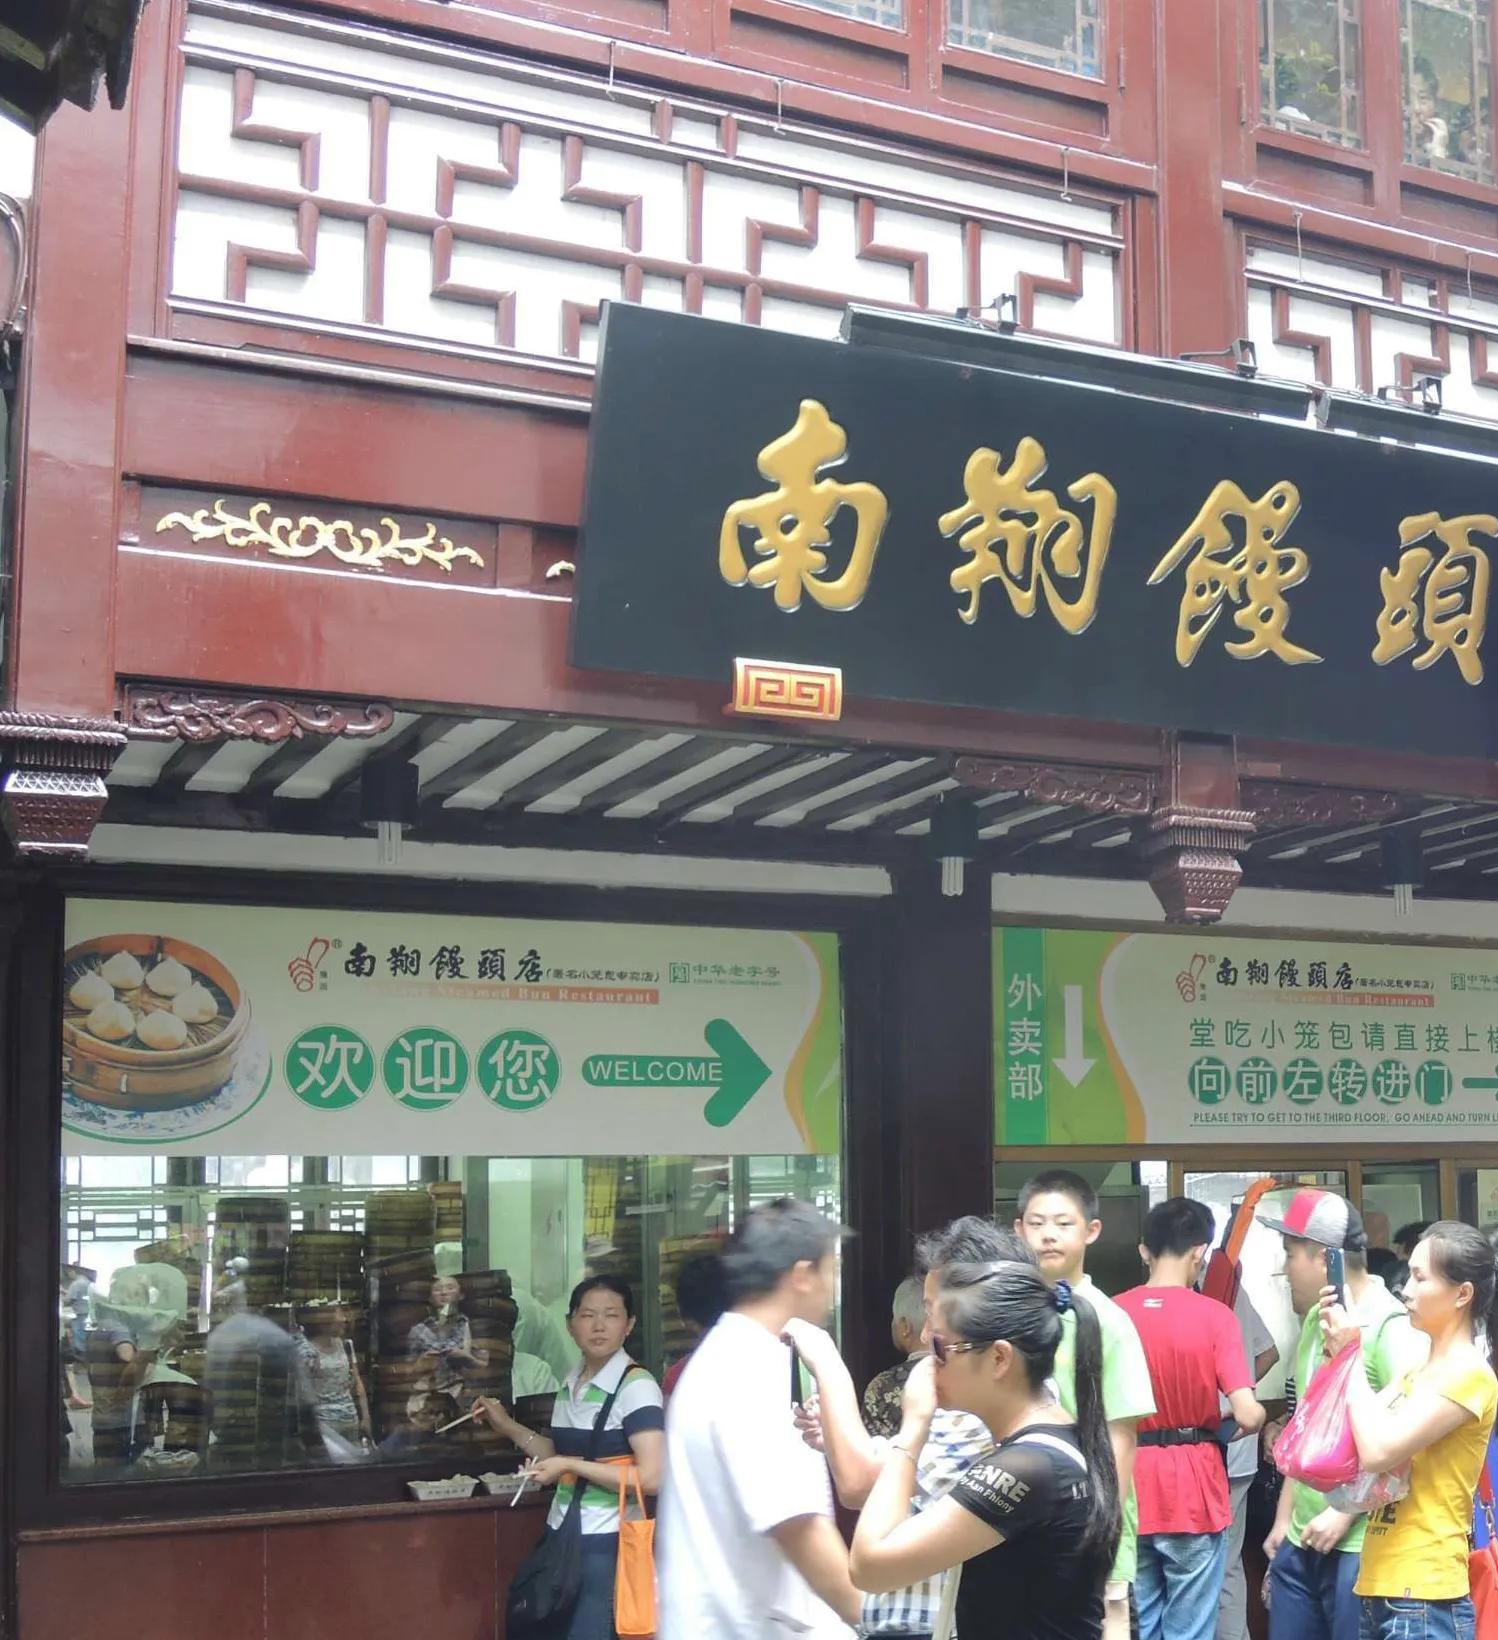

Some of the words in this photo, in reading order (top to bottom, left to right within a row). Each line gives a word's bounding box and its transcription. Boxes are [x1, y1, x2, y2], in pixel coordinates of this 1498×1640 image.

[559, 987, 653, 1003] Restaurant
[1008, 973, 1043, 1101] 外卖部
[296, 1034, 553, 1102] 欢迎您
[588, 1060, 724, 1082] WELCOME
[1193, 1058, 1450, 1103] 向前左转进门
[1193, 1112, 1229, 1123] PLEASE
[1231, 1112, 1249, 1123] TRY
[1252, 1112, 1265, 1123] TO
[1267, 1112, 1287, 1123] GET
[1289, 1112, 1302, 1123] TO
[1304, 1112, 1321, 1123] THE
[1323, 1112, 1351, 1123] THIRD
[1394, 1112, 1411, 1123] GO
[1412, 1112, 1444, 1123] AHEAD
[1446, 1112, 1466, 1123] AND
[1468, 1112, 1491, 1123] TURN
